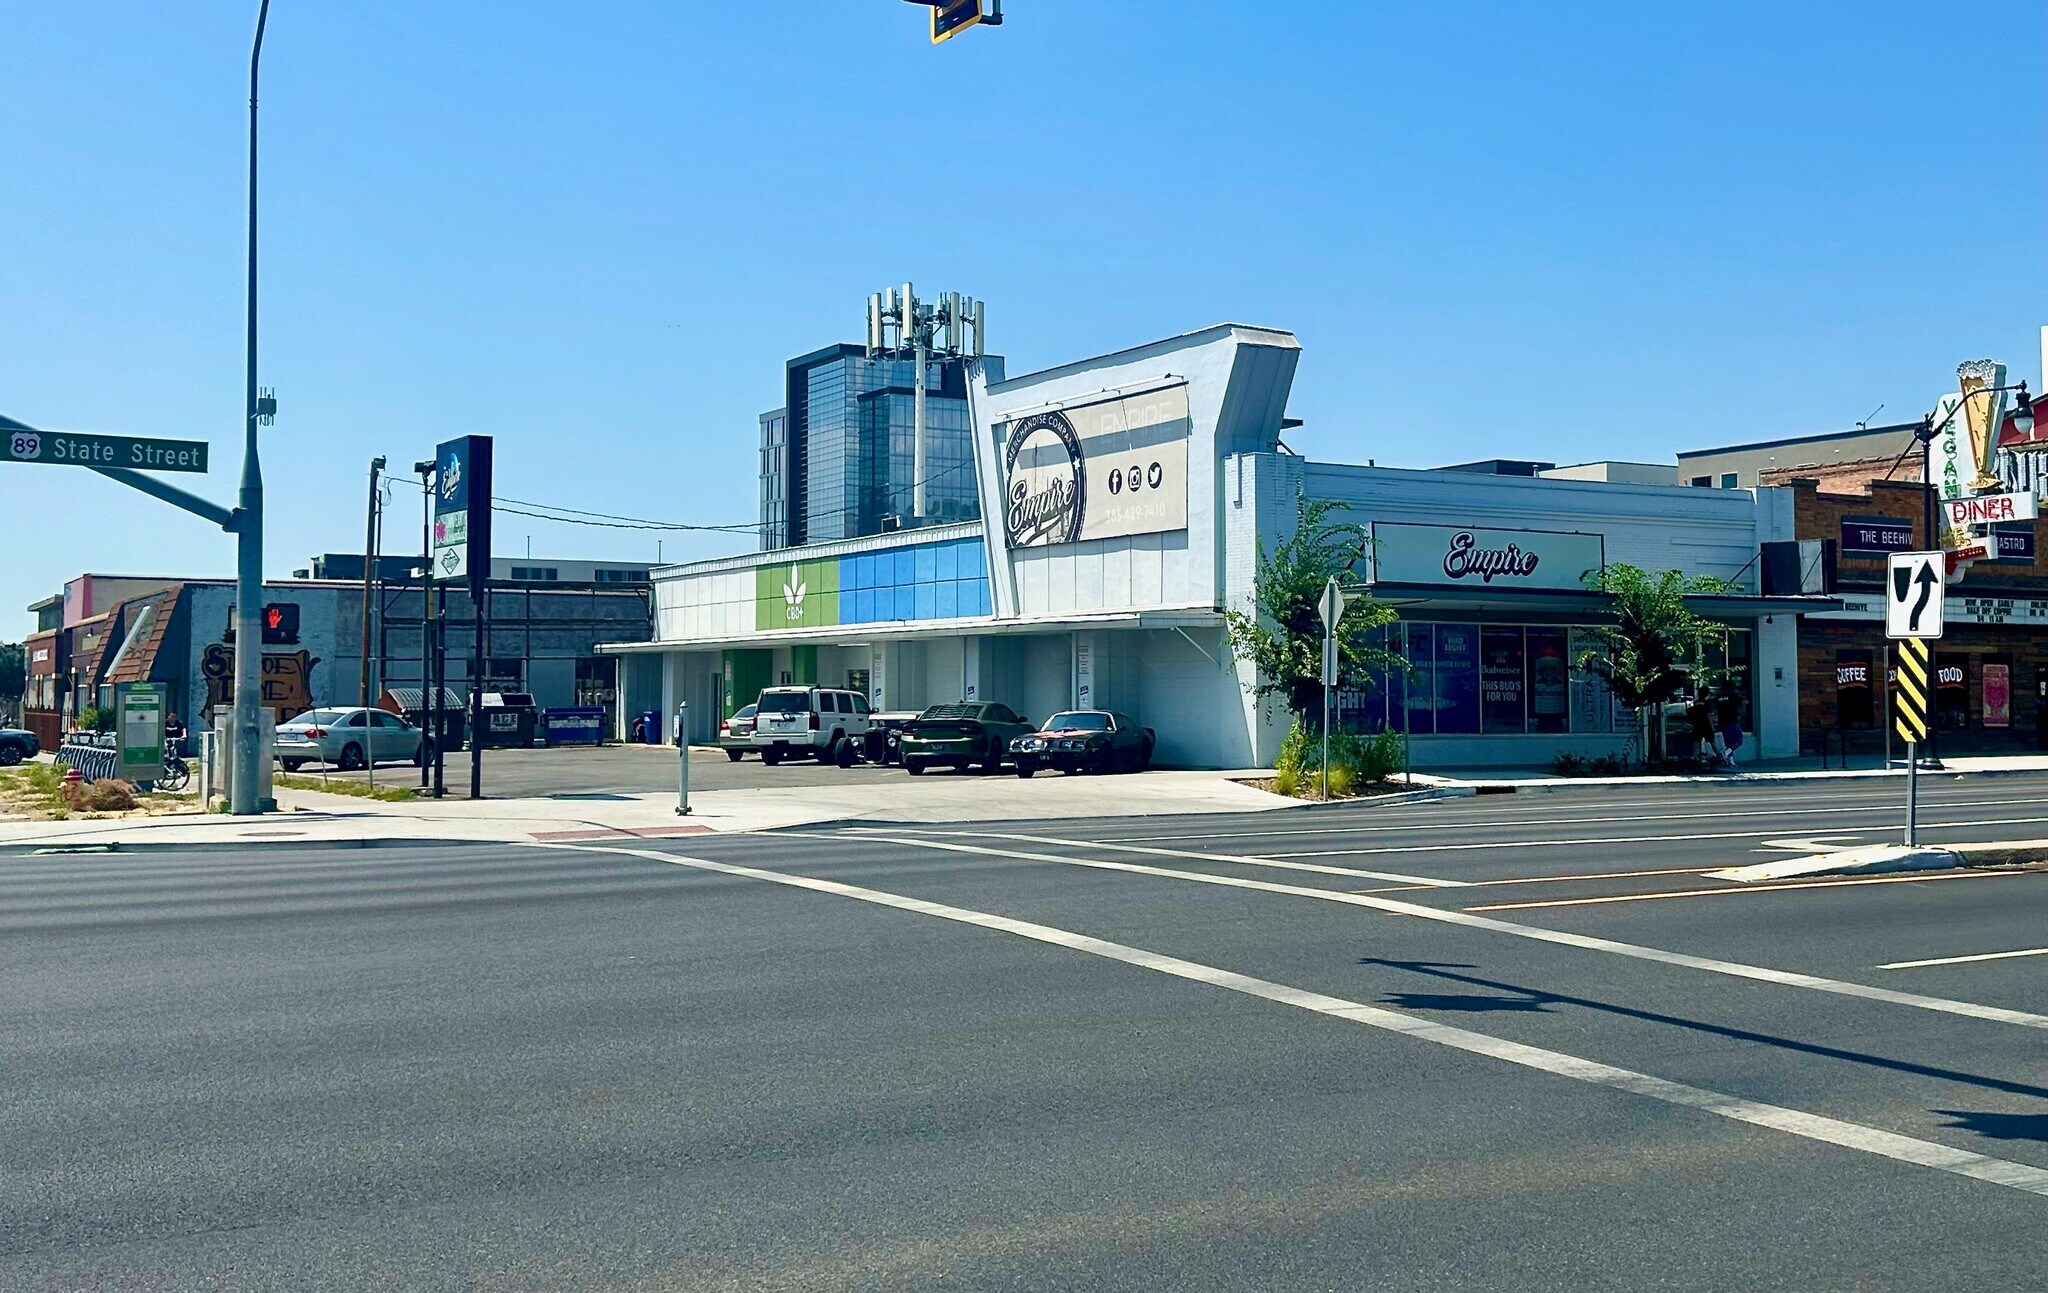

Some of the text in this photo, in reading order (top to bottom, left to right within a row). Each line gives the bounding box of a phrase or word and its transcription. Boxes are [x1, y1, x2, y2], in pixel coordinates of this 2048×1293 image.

[1007, 414, 1076, 464] MERCHANDISE COMPANY
[13, 438, 199, 467] 89 State Street
[1942, 398, 1962, 499] VEGAN
[1007, 476, 1076, 534] Empire
[1953, 498, 2016, 523] DINER
[1860, 530, 1877, 543] THE
[1443, 531, 1540, 583] Empire
[1980, 599, 1994, 607] OPEN
[1997, 599, 2015, 608] EARLY
[1444, 643, 1467, 652] LIGHT
[1481, 664, 1521, 675] Budweiser
[1837, 667, 1866, 684] COFFEE
[1937, 667, 1963, 684] FOOD
[1482, 681, 1521, 691] THIS BUD'S
[1486, 691, 1517, 702] FOR YOU
[492, 714, 517, 723] ACE
